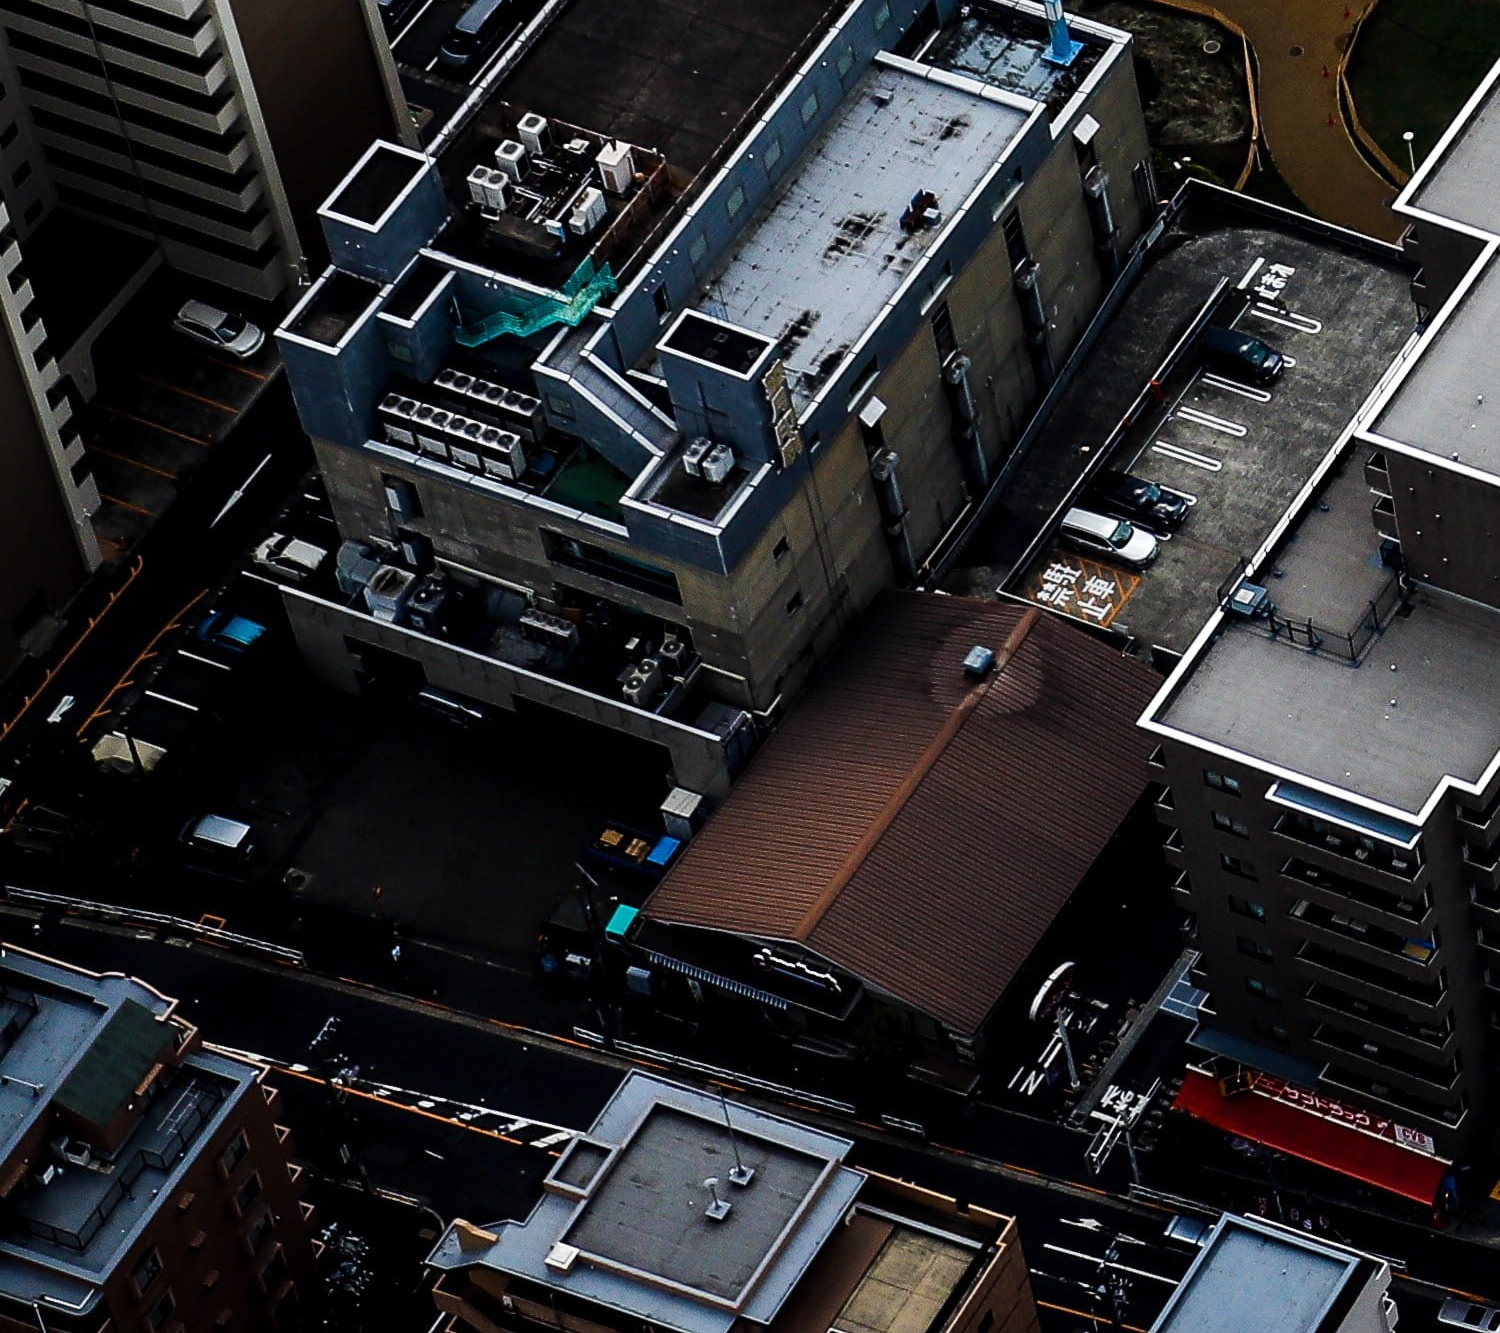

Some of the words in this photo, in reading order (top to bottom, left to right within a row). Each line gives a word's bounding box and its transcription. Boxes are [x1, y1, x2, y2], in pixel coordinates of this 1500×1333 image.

[1254, 262, 1297, 301] 止まれ
[1041, 561, 1117, 601] 駐車
[1035, 582, 1114, 622] 禁止
